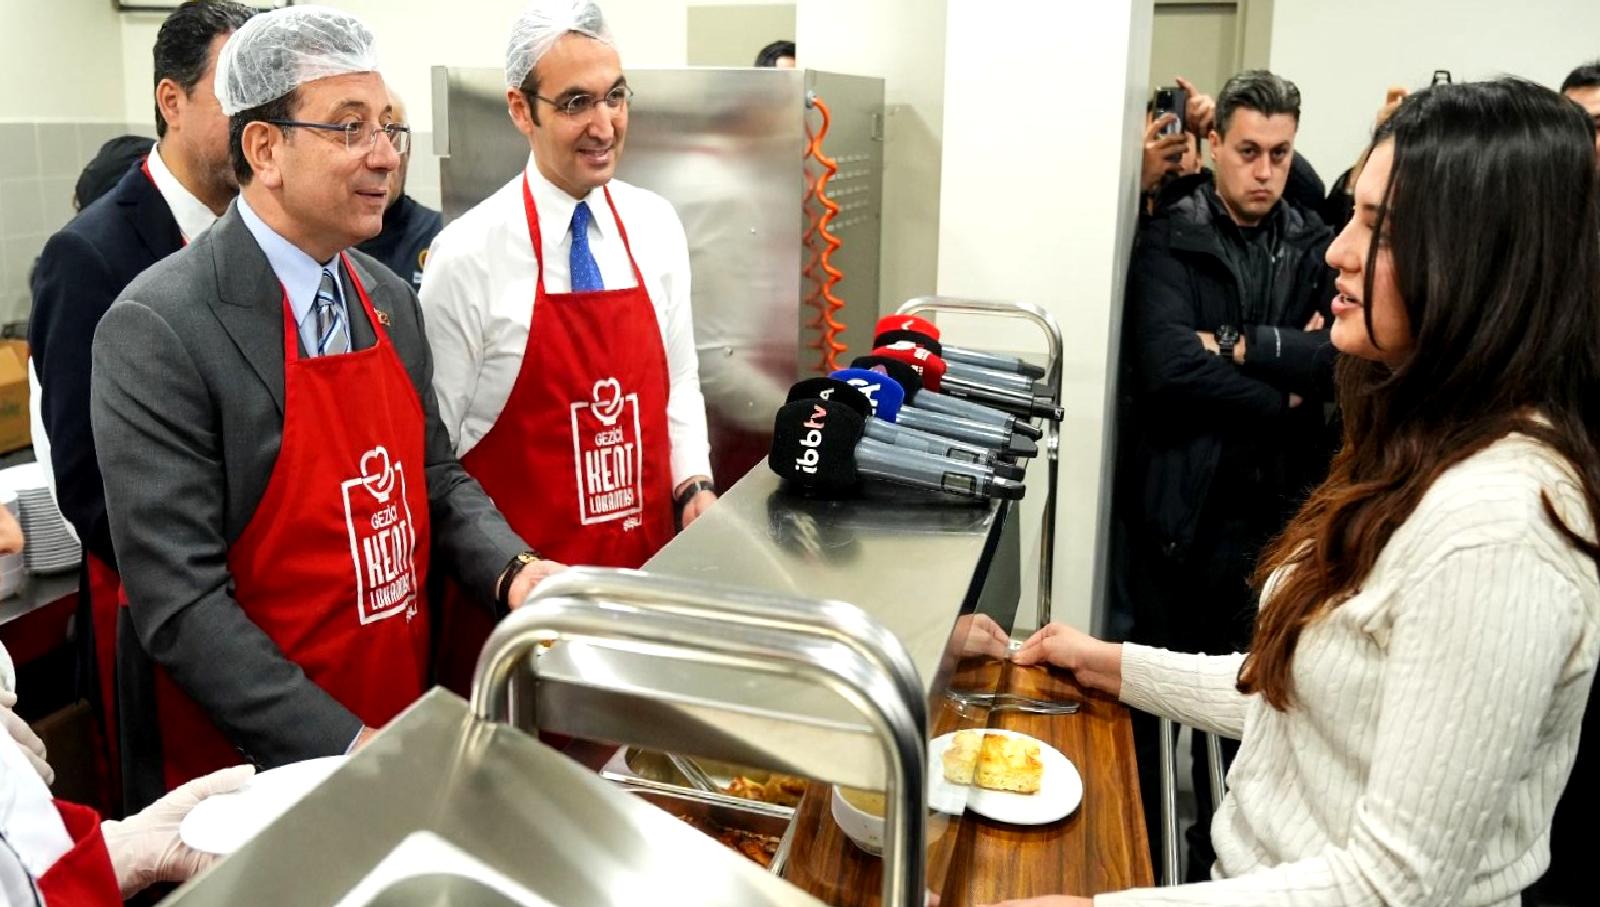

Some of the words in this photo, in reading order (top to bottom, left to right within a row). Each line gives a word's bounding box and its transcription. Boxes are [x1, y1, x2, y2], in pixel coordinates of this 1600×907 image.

[585, 443, 634, 495] KENT
[795, 403, 827, 474] ibbtv
[363, 519, 407, 589] KENT
